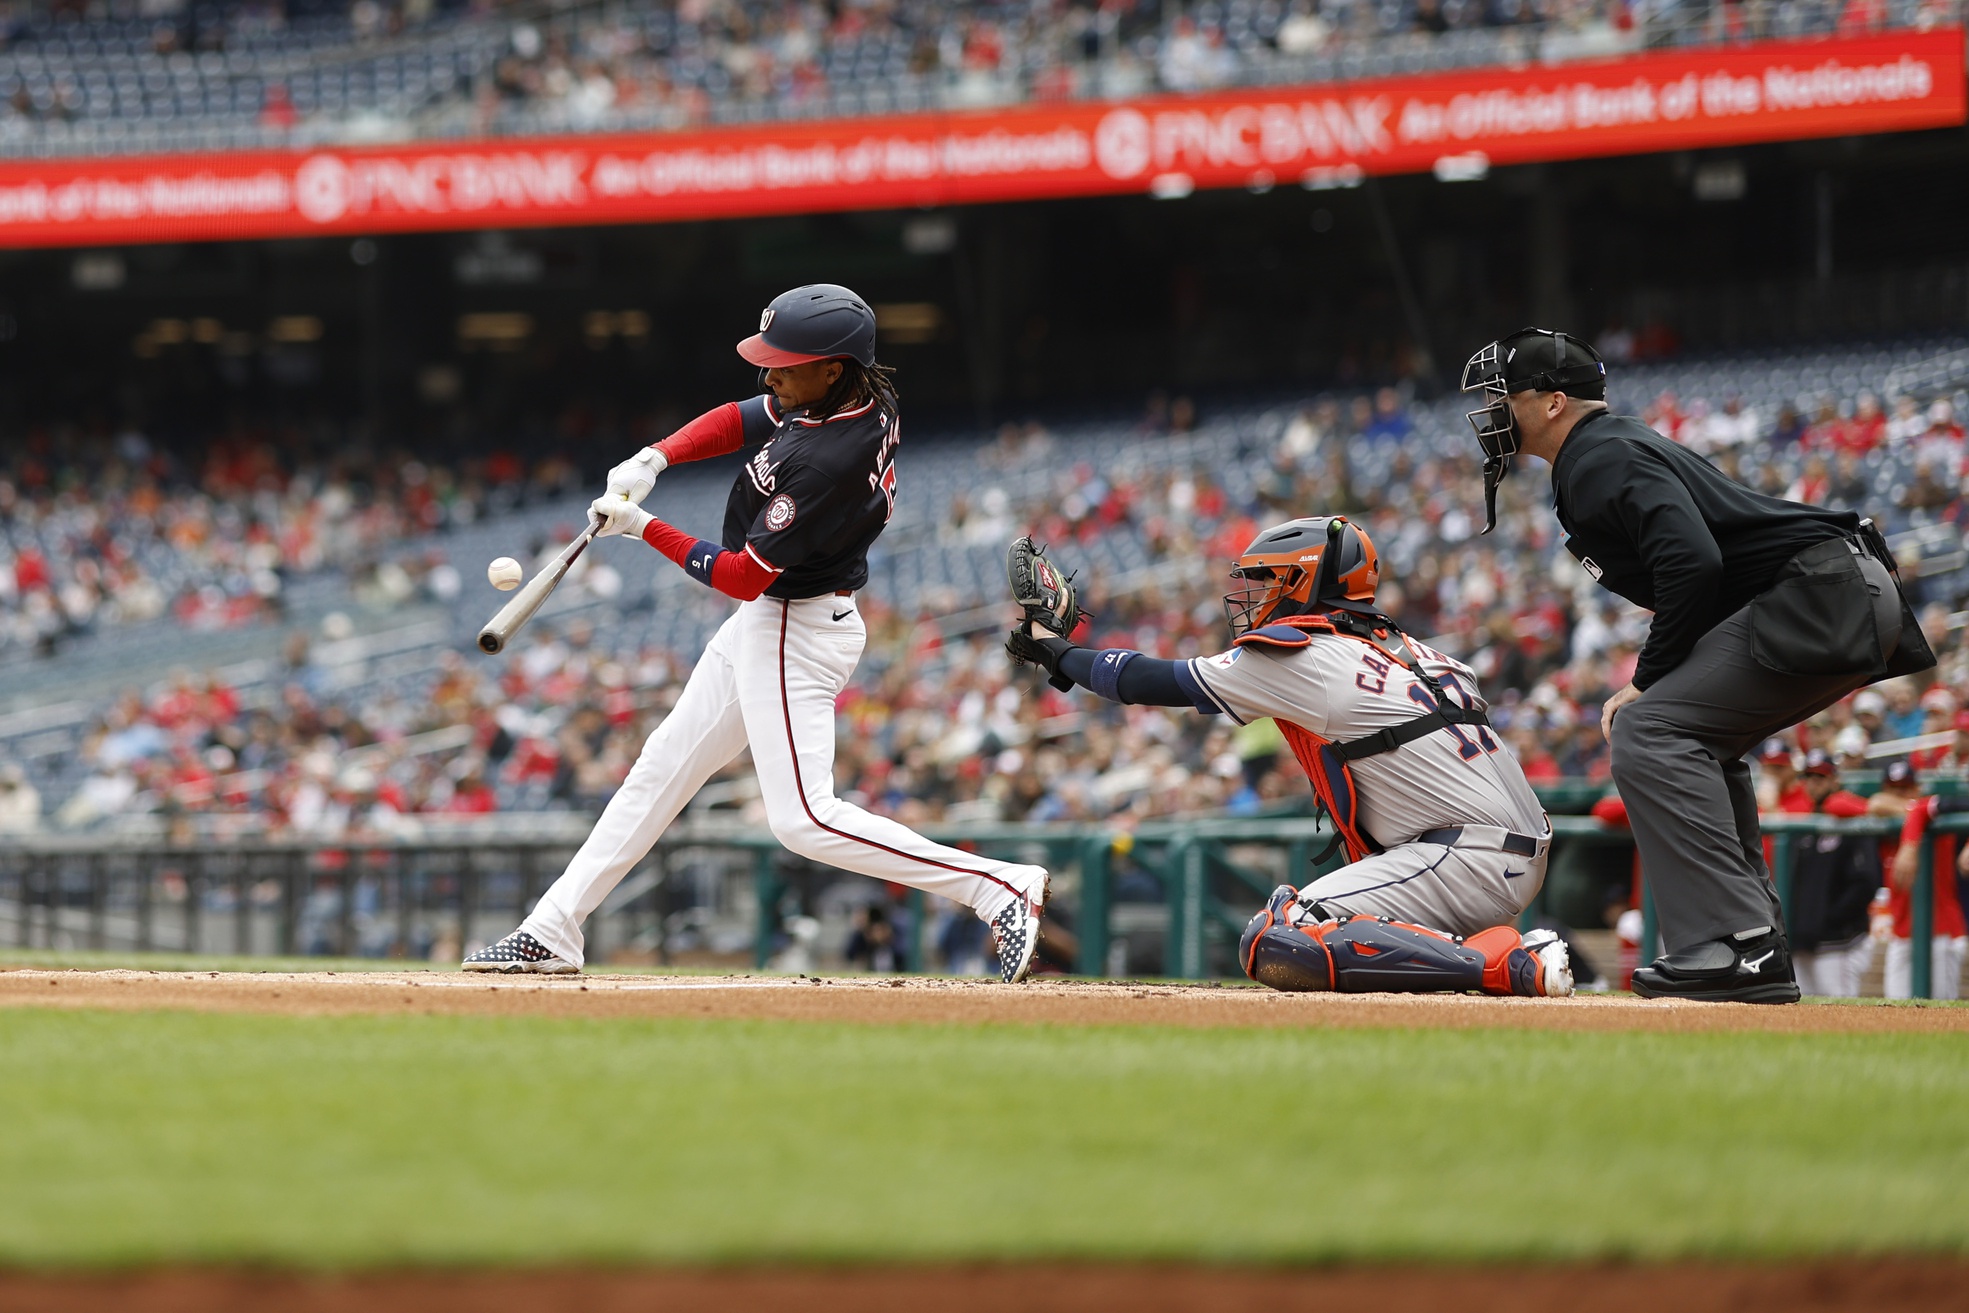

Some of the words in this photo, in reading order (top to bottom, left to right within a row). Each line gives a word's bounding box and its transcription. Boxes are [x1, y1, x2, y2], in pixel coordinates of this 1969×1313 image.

[1400, 97, 1447, 144] An
[1450, 84, 1567, 140] Official
[1572, 77, 1657, 128] Bank
[1659, 71, 1699, 121] of
[1702, 69, 1761, 118] the
[1764, 54, 1932, 112] Nationals
[937, 124, 1091, 177] Nationals
